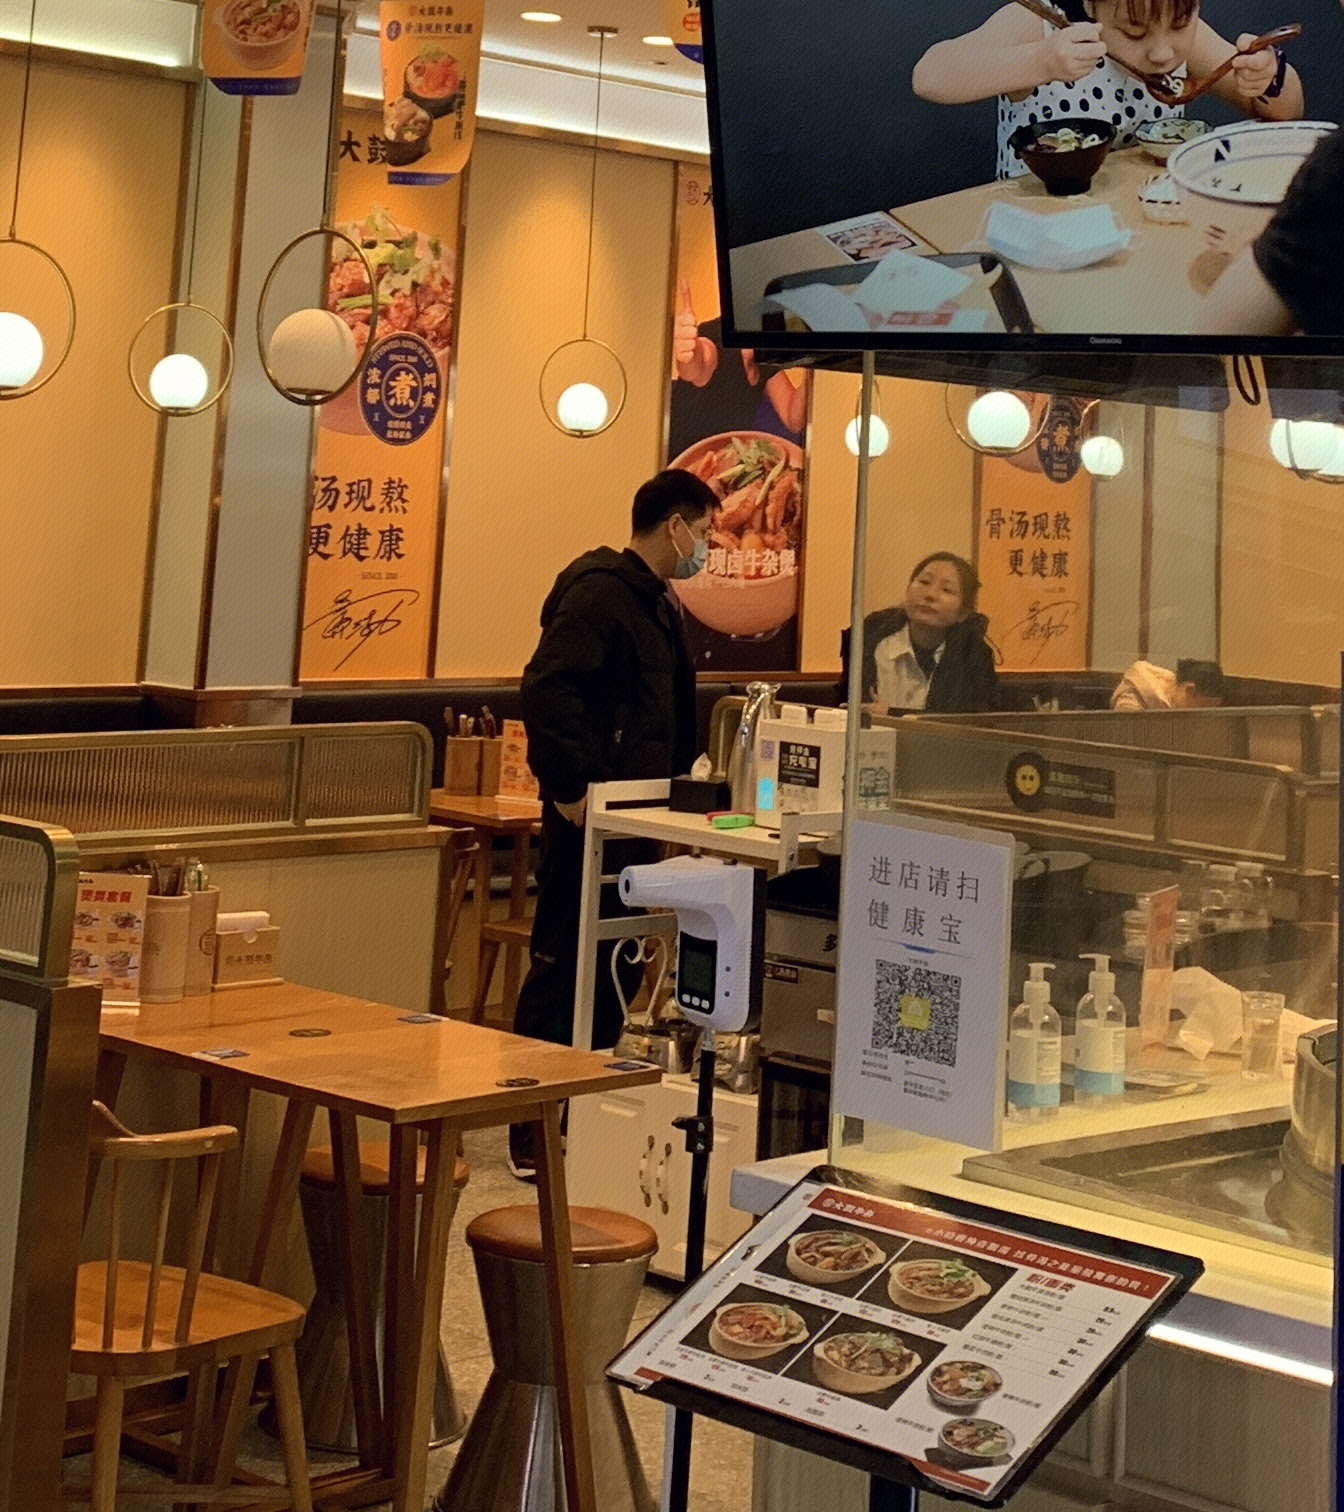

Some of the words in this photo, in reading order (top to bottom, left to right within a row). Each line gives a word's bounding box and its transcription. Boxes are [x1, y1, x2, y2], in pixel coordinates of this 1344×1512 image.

[307, 522, 407, 563] 更健康
[1006, 548, 1070, 581] 更健康
[868, 855, 980, 904] 进店请扫
[867, 897, 964, 946] 健康宝
